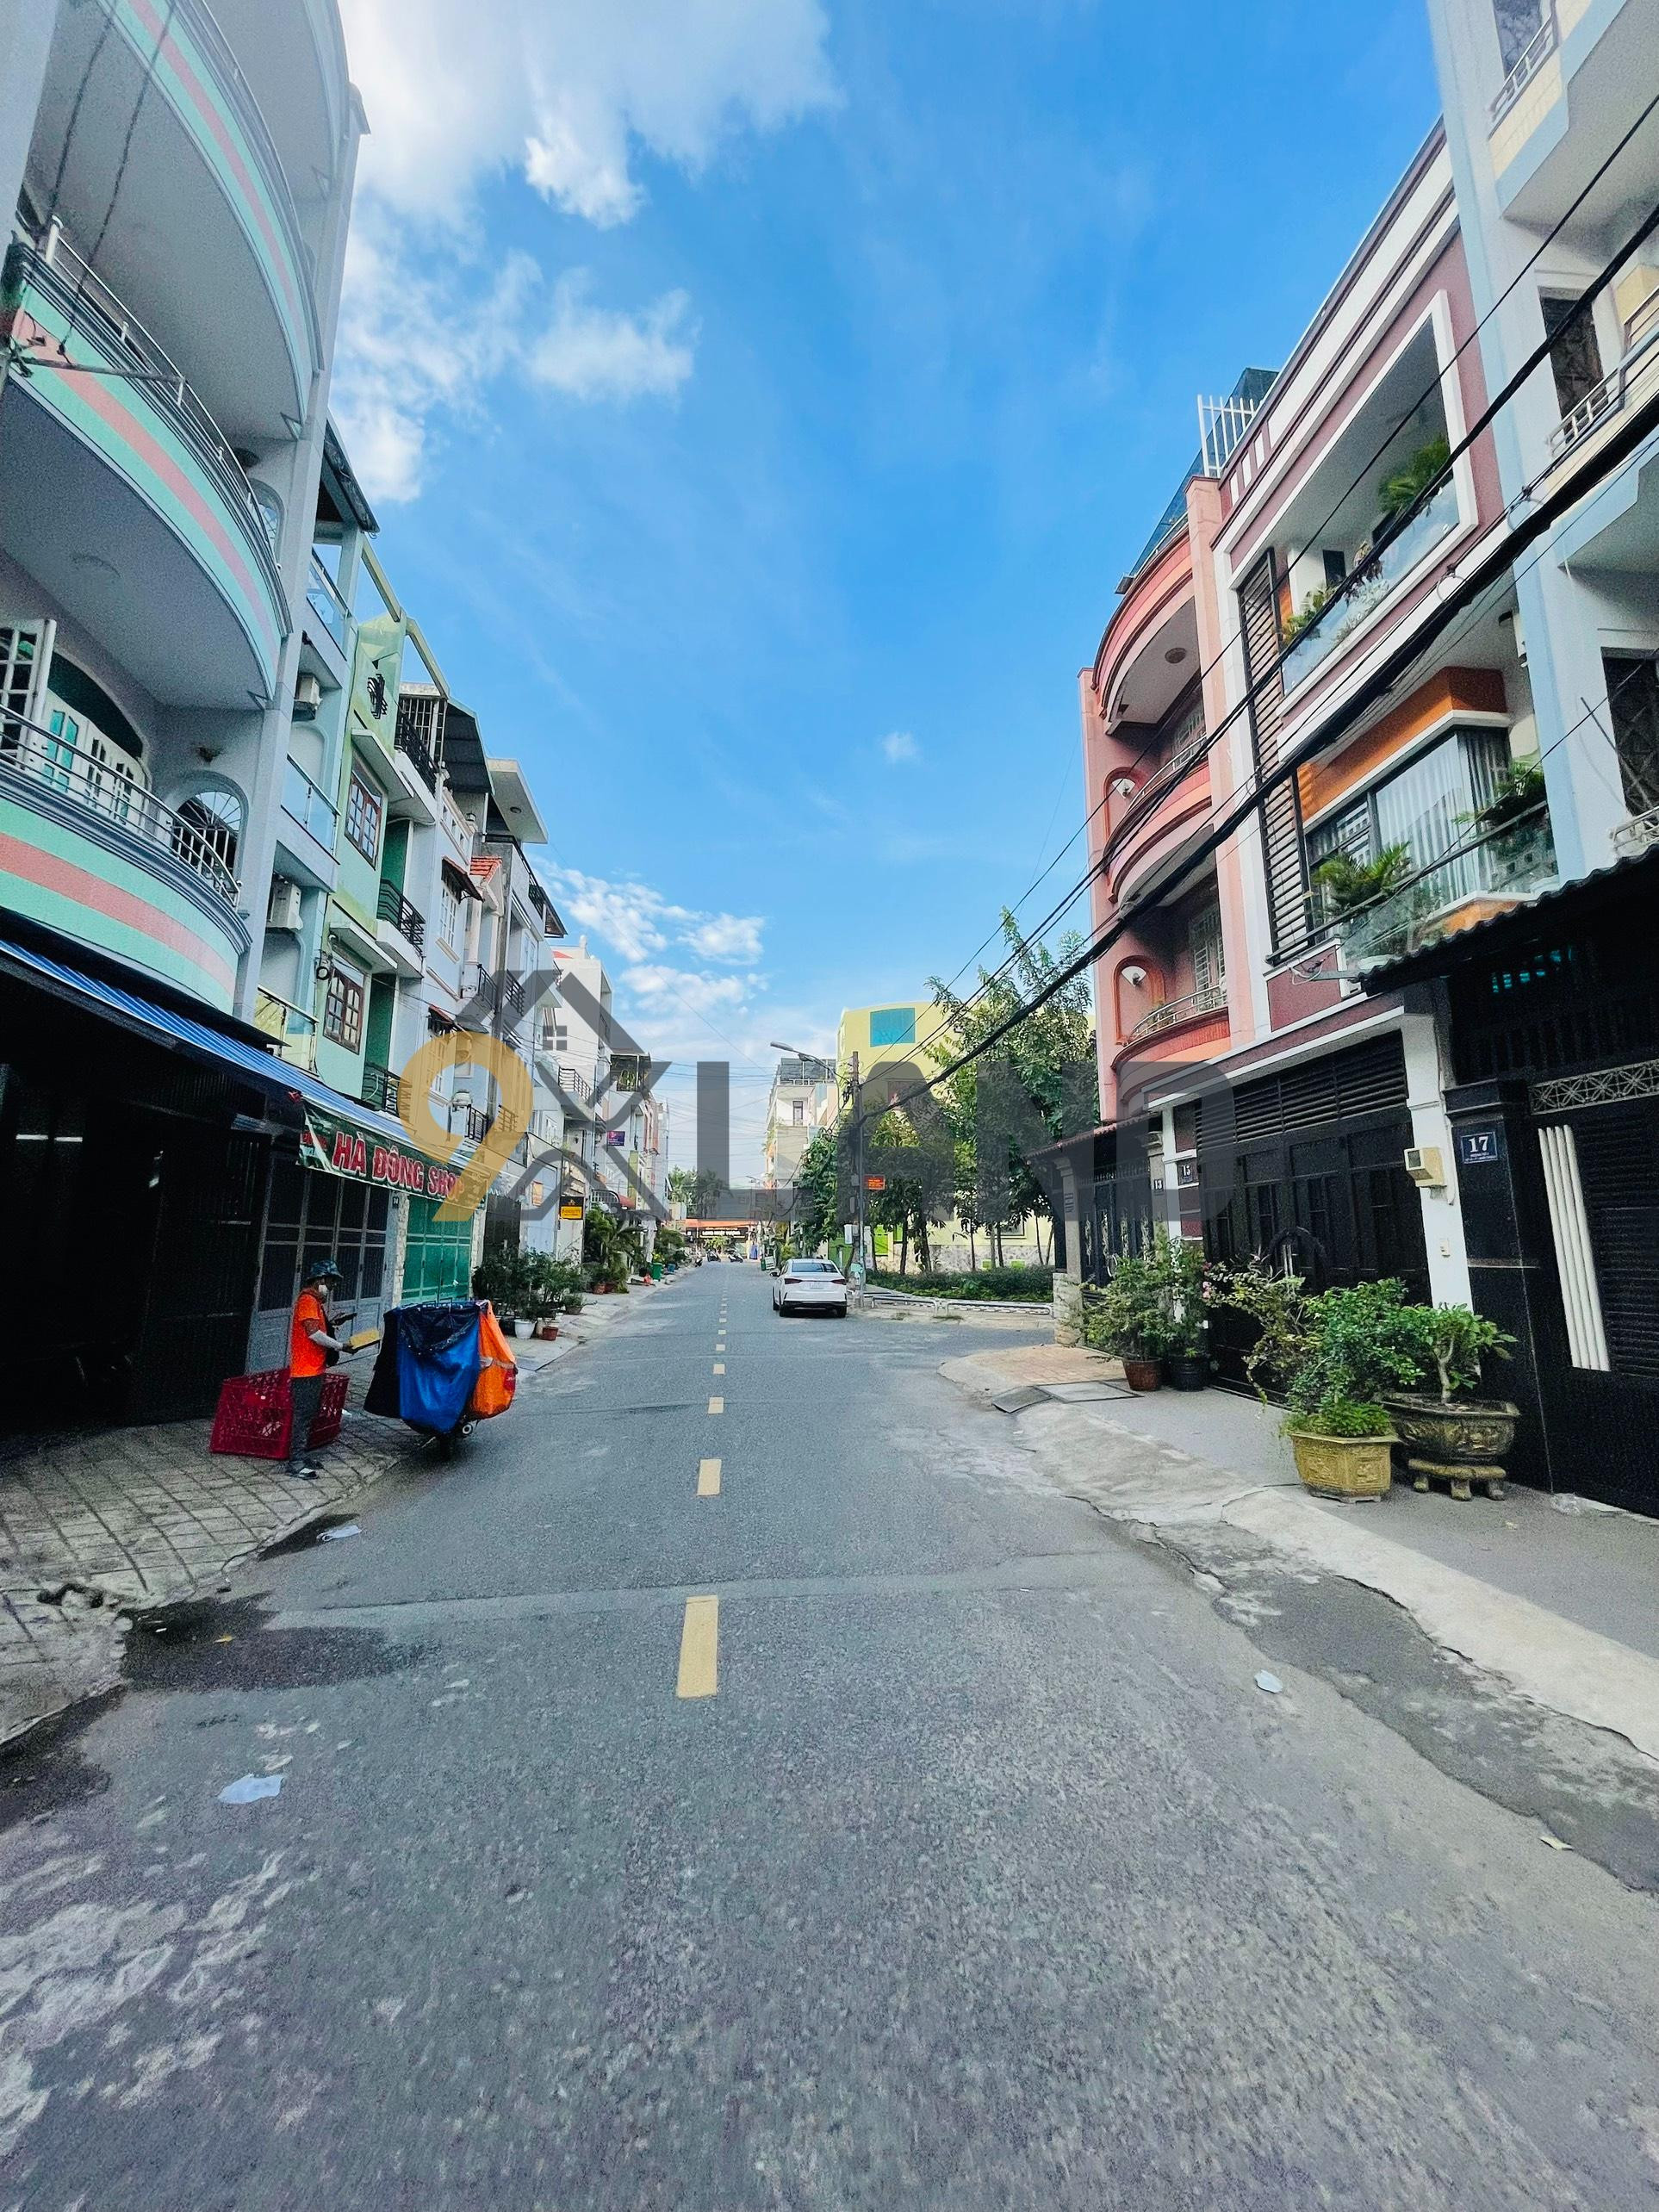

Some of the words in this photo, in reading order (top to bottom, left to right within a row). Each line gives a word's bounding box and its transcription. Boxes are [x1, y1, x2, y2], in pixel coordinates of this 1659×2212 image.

[1469, 1136, 1488, 1153] 17
[332, 1131, 367, 1177] HÀ
[372, 1145, 424, 1192] ĐÔNG
[428, 1165, 464, 1202] SHOP
[1183, 1165, 1191, 1177] 15
[1154, 1179, 1163, 1190] 13
